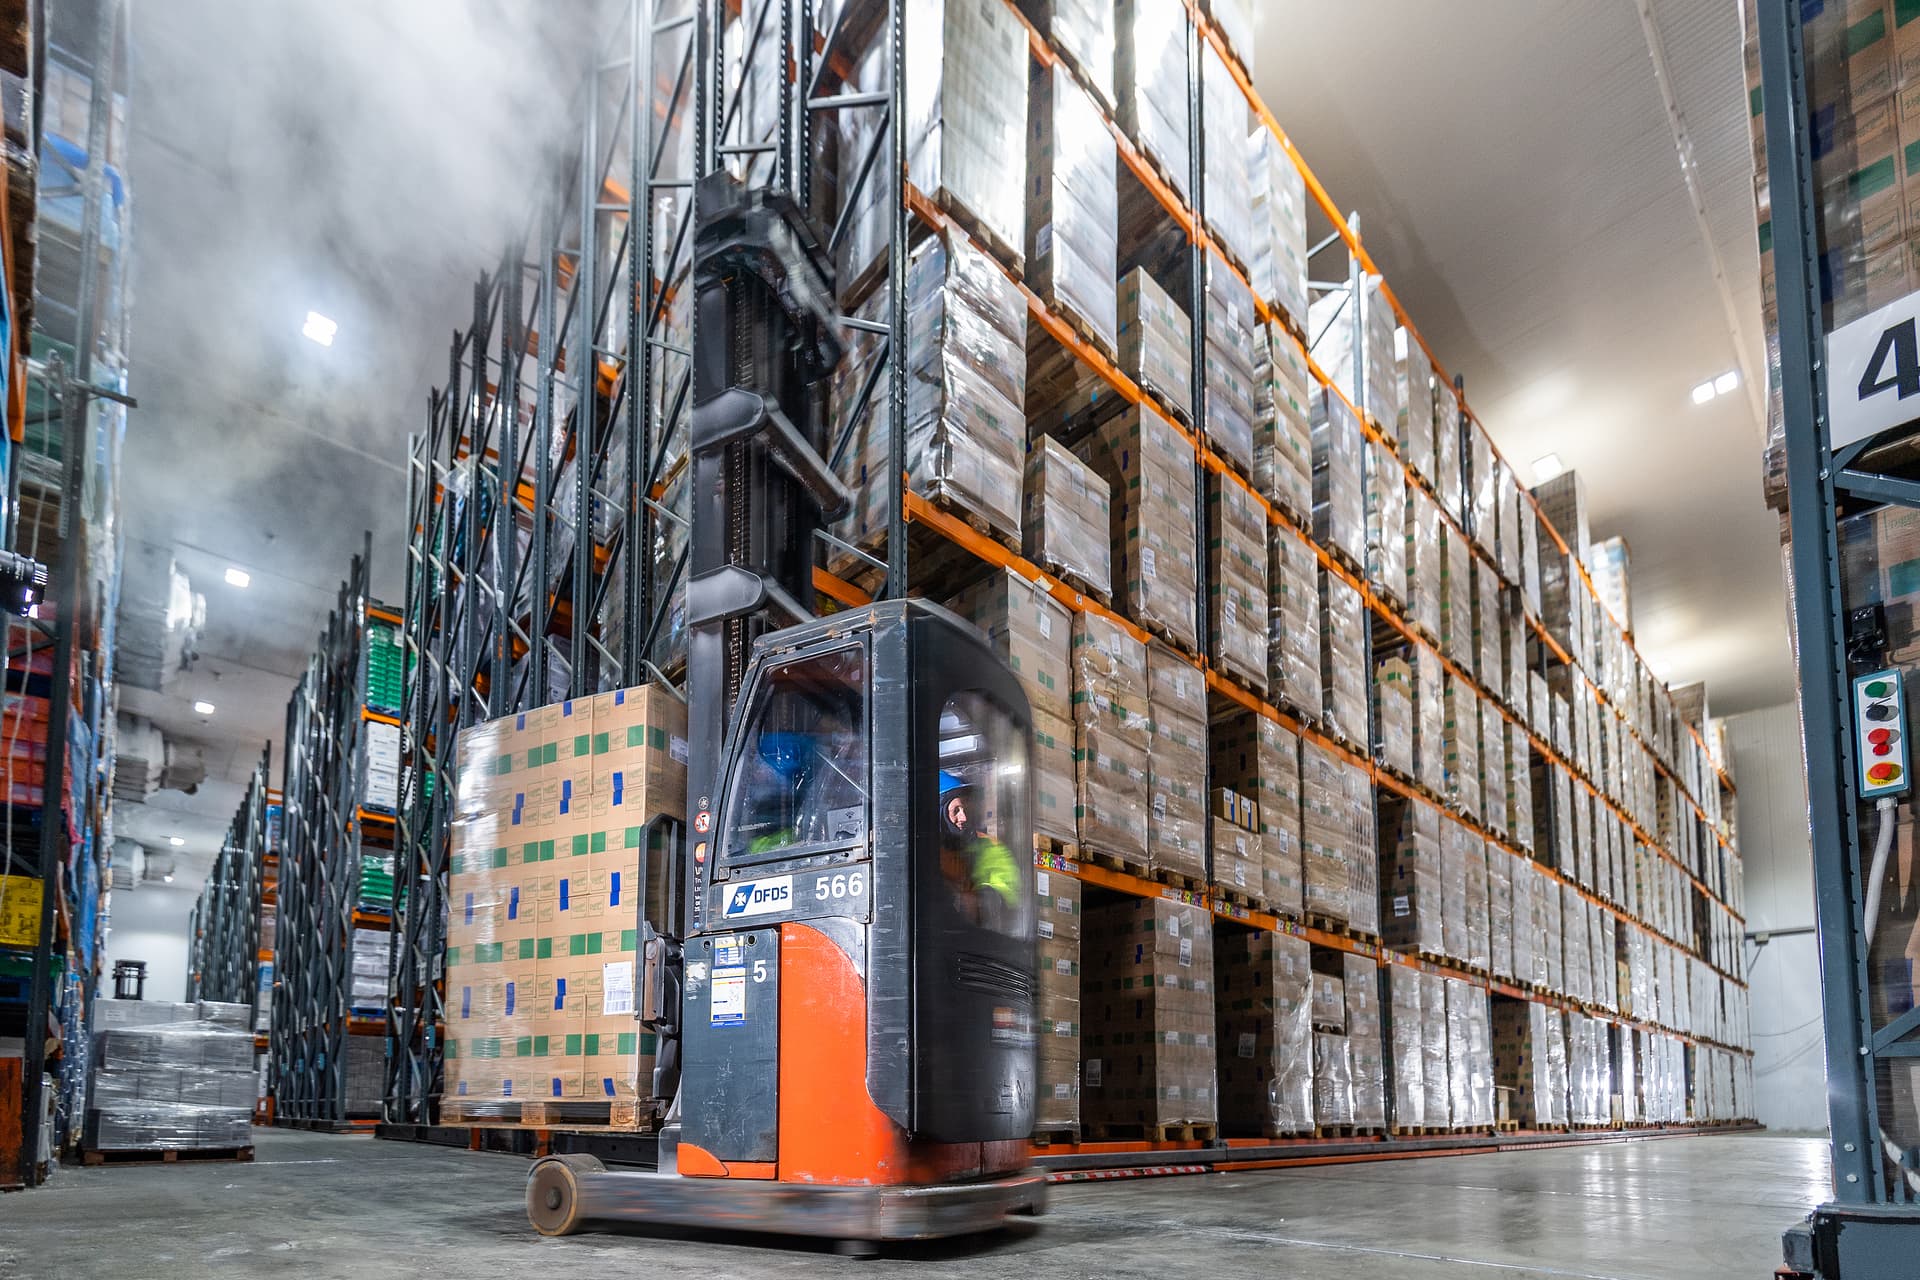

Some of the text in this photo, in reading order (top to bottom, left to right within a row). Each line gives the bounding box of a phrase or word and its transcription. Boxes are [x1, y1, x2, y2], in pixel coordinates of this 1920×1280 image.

[1858, 316, 1920, 401] 4
[754, 885, 788, 904] DFDS
[815, 872, 863, 901] 566
[752, 959, 767, 983] 5
